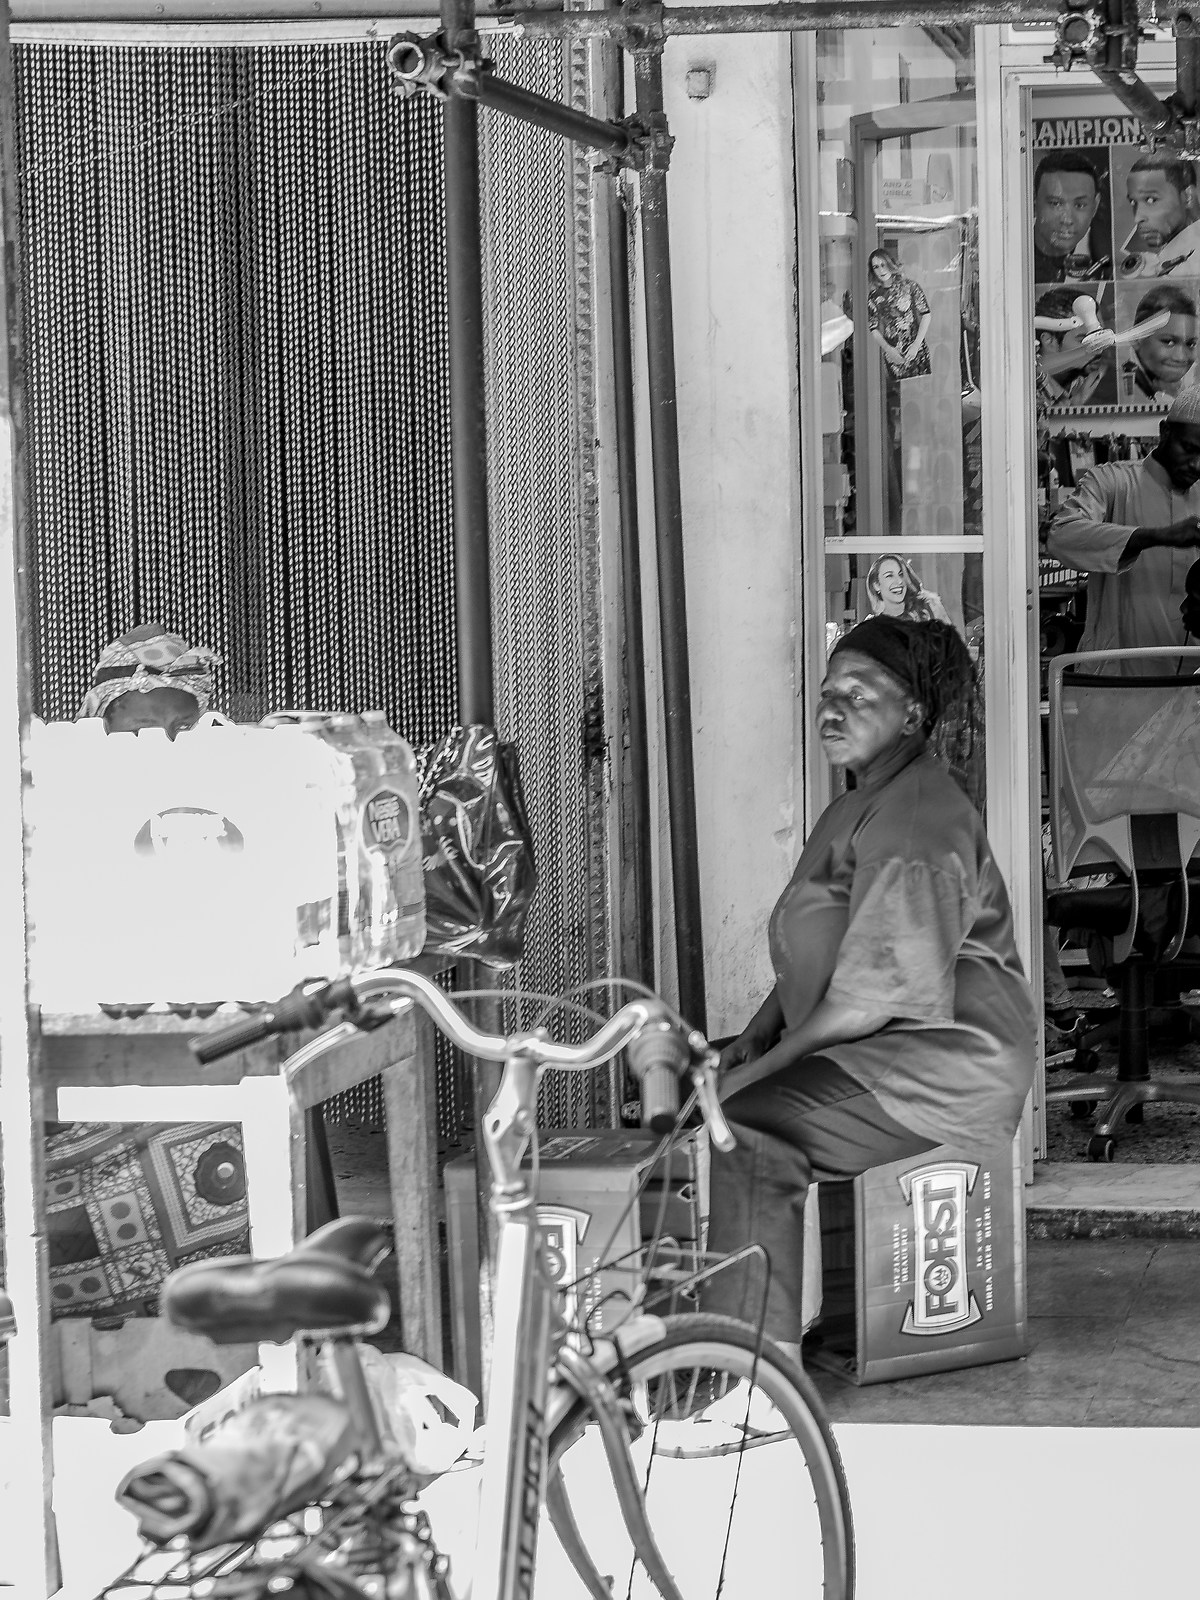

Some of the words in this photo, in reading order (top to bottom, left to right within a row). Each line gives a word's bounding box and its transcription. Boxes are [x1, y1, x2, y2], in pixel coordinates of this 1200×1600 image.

[1032, 117, 1141, 141] AMPION
[983, 1171, 991, 1200] BEER
[984, 1205, 992, 1238] BIÈRE
[923, 1179, 960, 1318] FORST
[976, 1256, 983, 1268] 16
[985, 1244, 993, 1271] BIER
[985, 1275, 993, 1311] BIRRA
